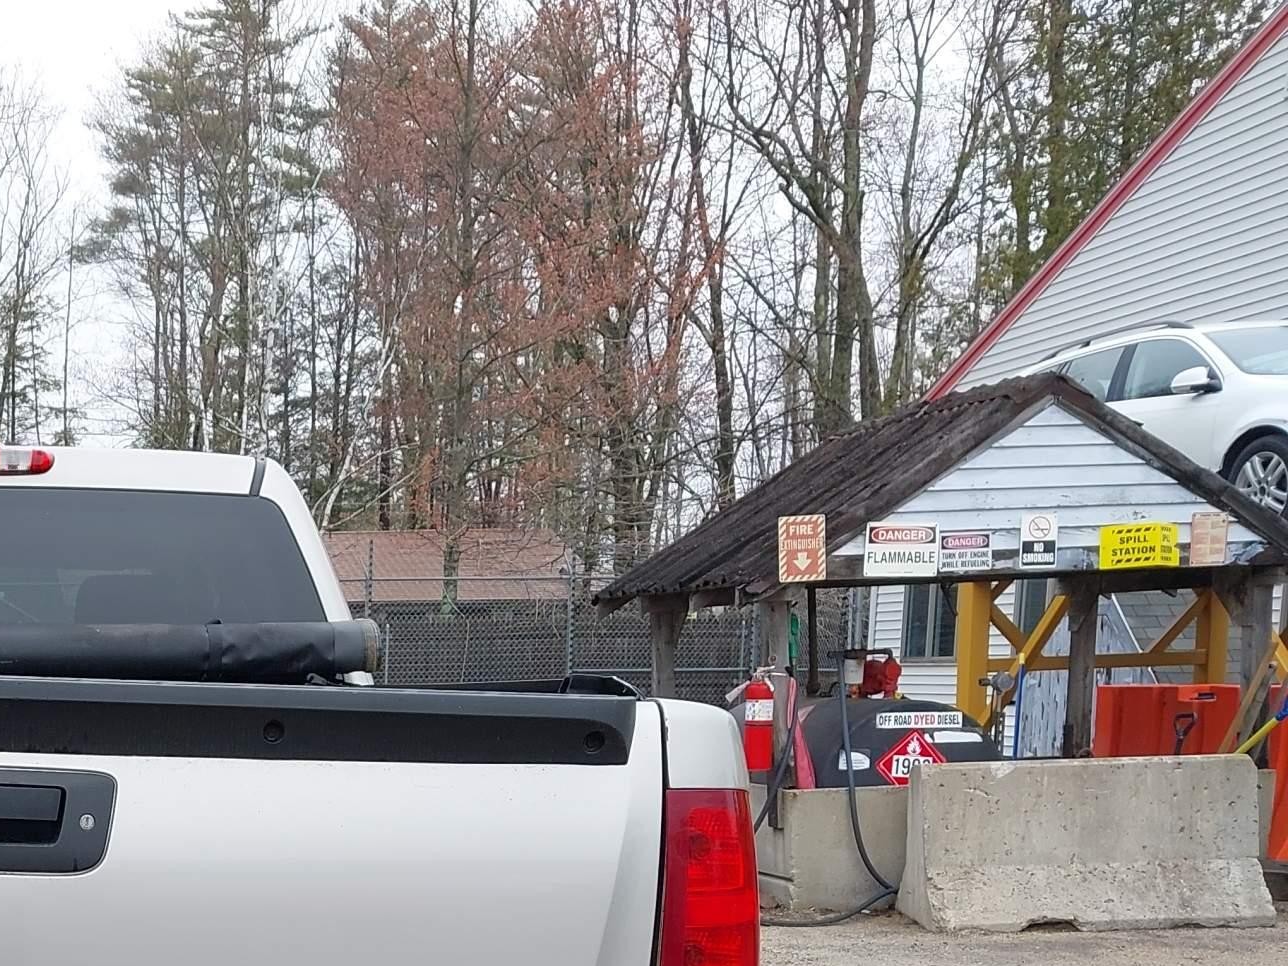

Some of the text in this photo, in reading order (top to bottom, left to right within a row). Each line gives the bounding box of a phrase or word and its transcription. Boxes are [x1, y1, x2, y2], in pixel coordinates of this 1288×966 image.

[789, 524, 814, 535] FIRE
[878, 530, 926, 541] DANGER
[948, 536, 984, 546] DANGER
[1119, 534, 1149, 545] SPILL
[780, 537, 824, 550] EXTINGUISHER
[1033, 542, 1045, 552] NO
[942, 550, 990, 560] TURN OFF ENGINE
[1111, 545, 1156, 557] STATION
[867, 551, 936, 564] FLAMMABLE
[1022, 552, 1054, 563] SMOKING
[942, 559, 990, 568] WHILE REFUELING
[879, 713, 961, 726] OFF ROAD DYED DIESEL
